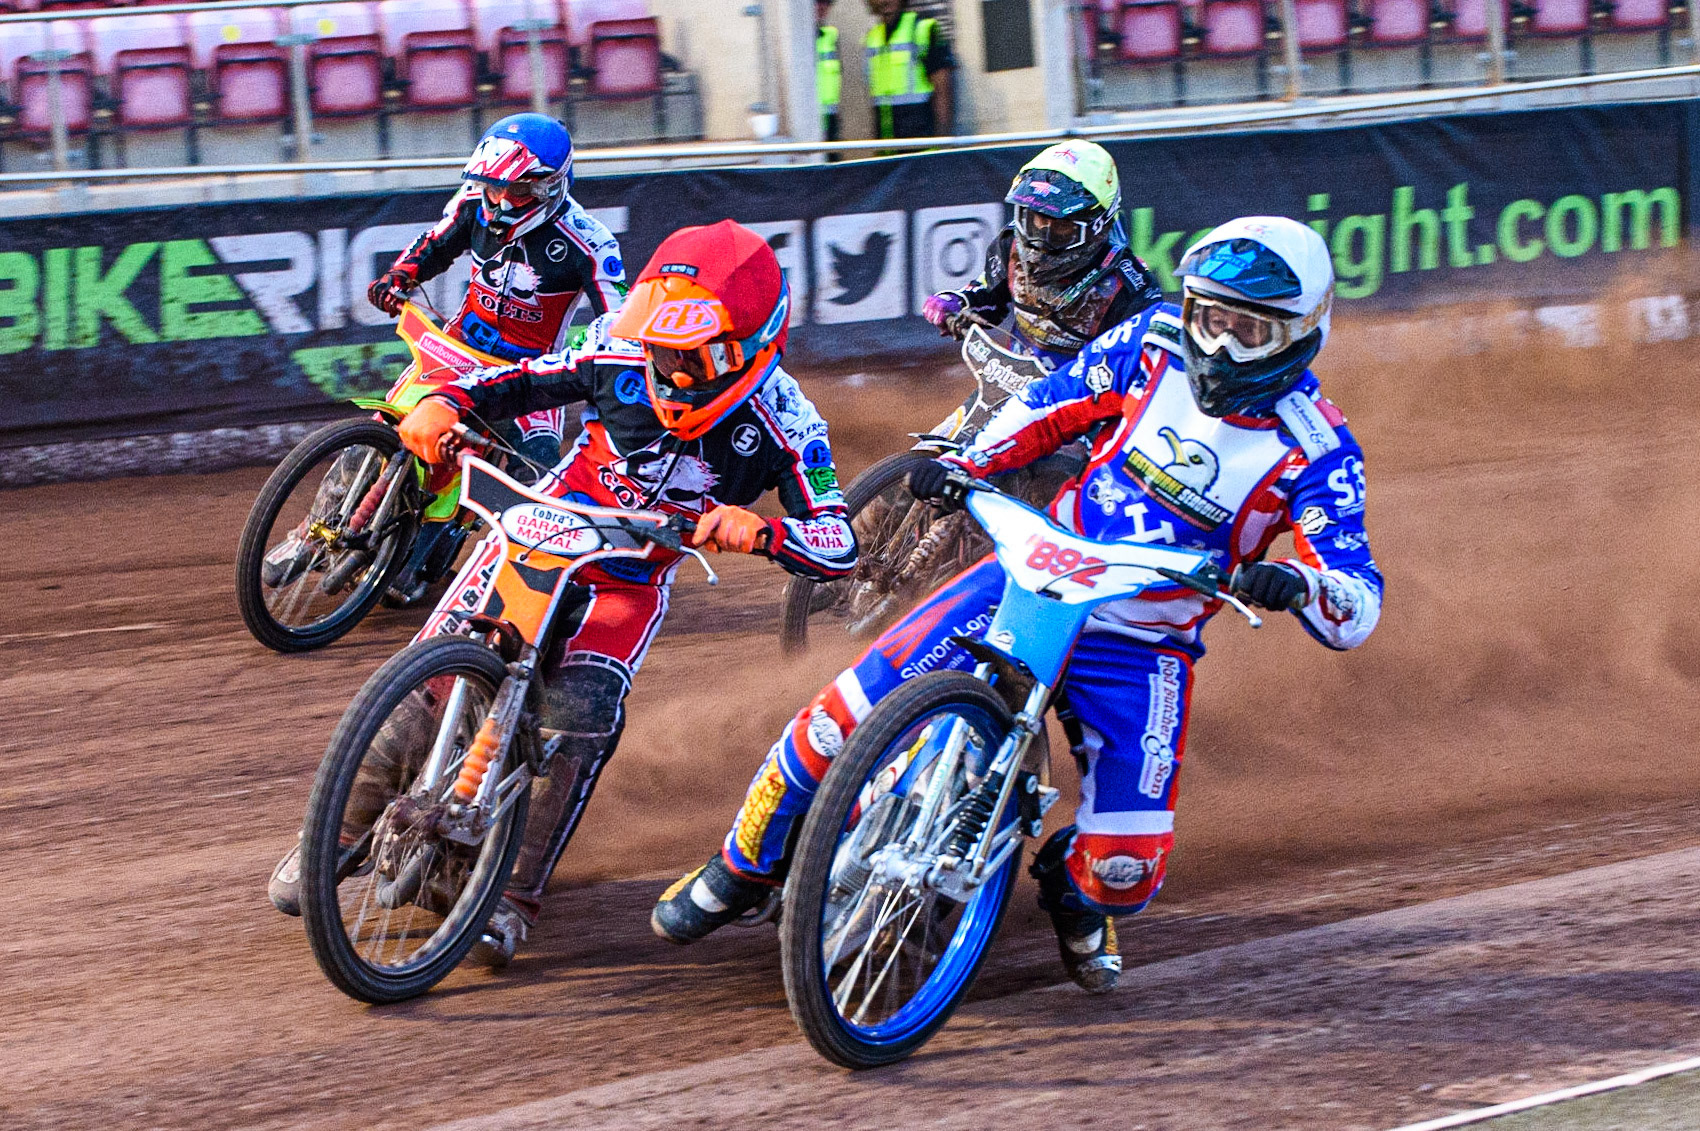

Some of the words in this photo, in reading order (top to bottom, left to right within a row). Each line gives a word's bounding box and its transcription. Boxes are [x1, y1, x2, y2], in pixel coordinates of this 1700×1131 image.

[517, 515, 584, 541] GARAGE
[532, 507, 575, 527] Cobra's
[1026, 541, 1108, 589] 892
[900, 636, 957, 680] Simon
[952, 613, 995, 637] Lon
[1150, 762, 1169, 795] Son
